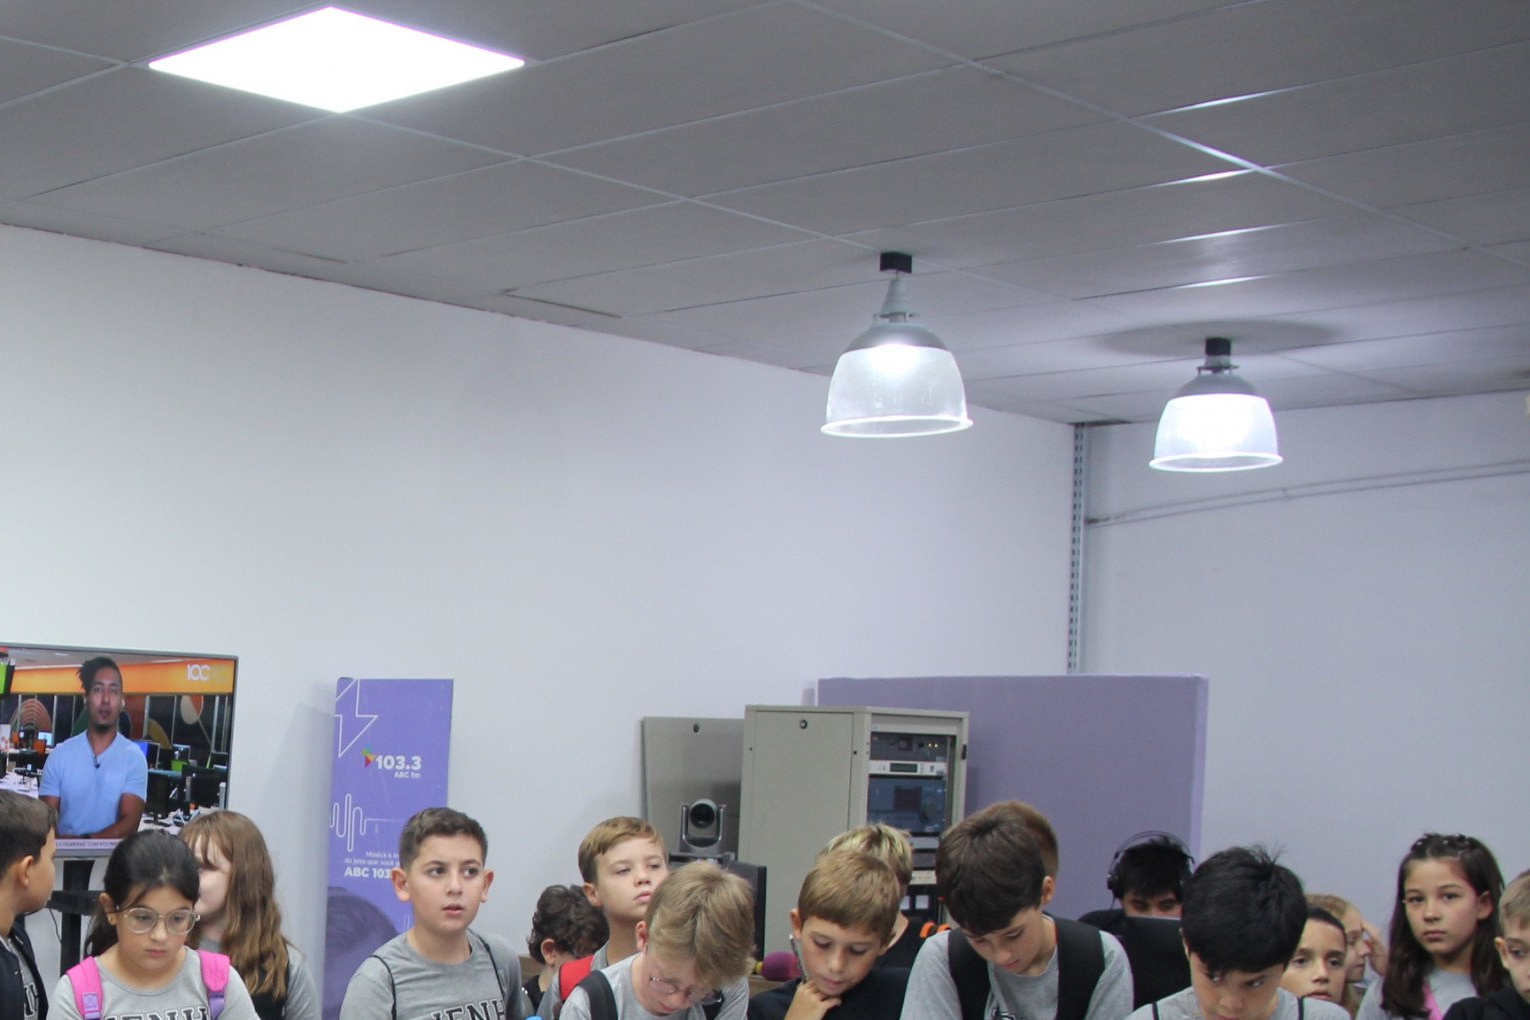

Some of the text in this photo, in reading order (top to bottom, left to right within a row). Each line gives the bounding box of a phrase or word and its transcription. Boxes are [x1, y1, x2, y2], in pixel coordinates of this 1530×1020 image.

[376, 754, 422, 771] 103.3
[394, 771, 421, 779] ABC fm
[344, 866, 370, 877] ABC
